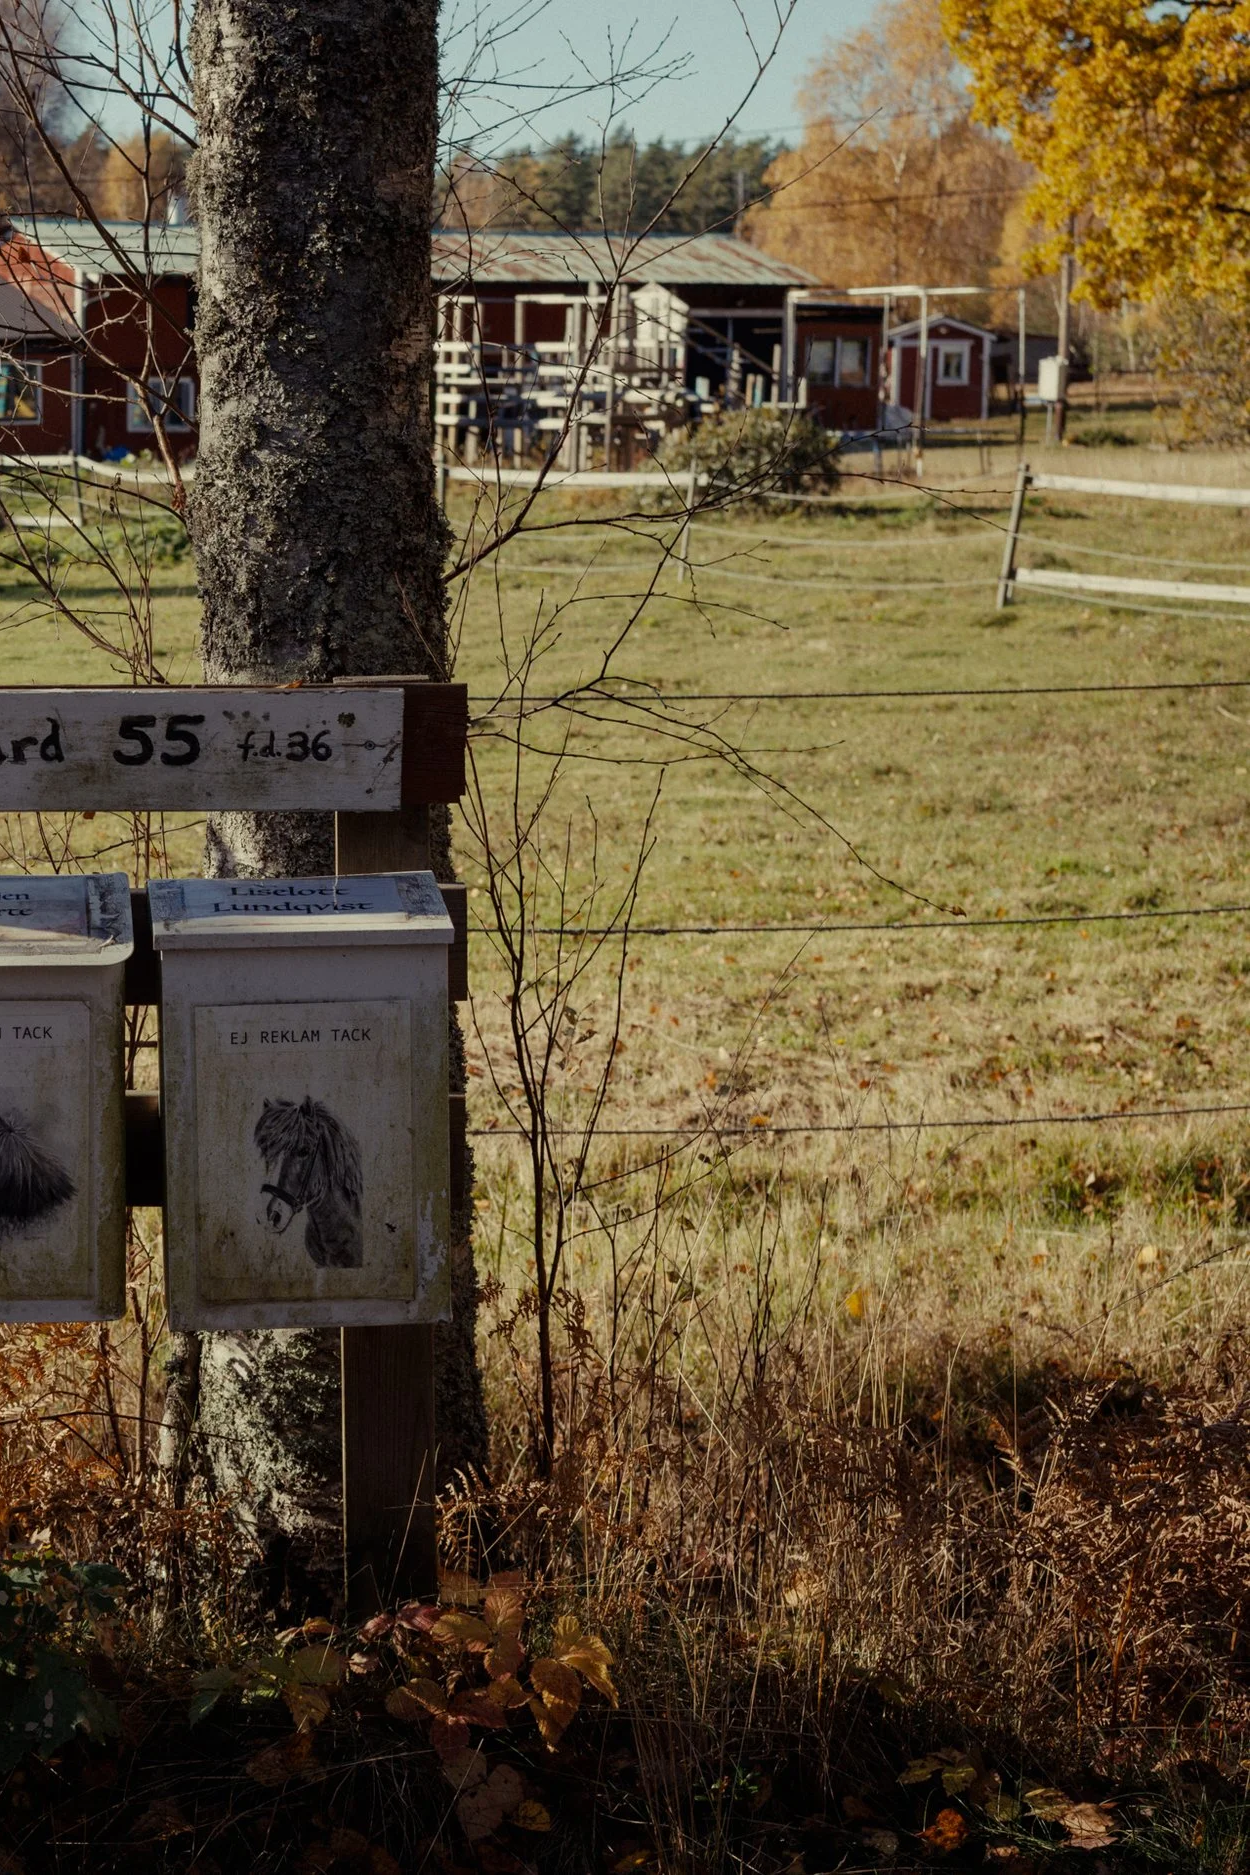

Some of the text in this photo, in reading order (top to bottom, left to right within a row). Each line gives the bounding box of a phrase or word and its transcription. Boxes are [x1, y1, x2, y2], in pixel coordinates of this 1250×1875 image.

[113, 714, 206, 766] 55
[229, 886, 350, 896] Liselott
[213, 901, 375, 914] Lundqvist
[12, 1026, 53, 1040] TACK
[230, 1028, 371, 1045] EJ REKLAM TACK
